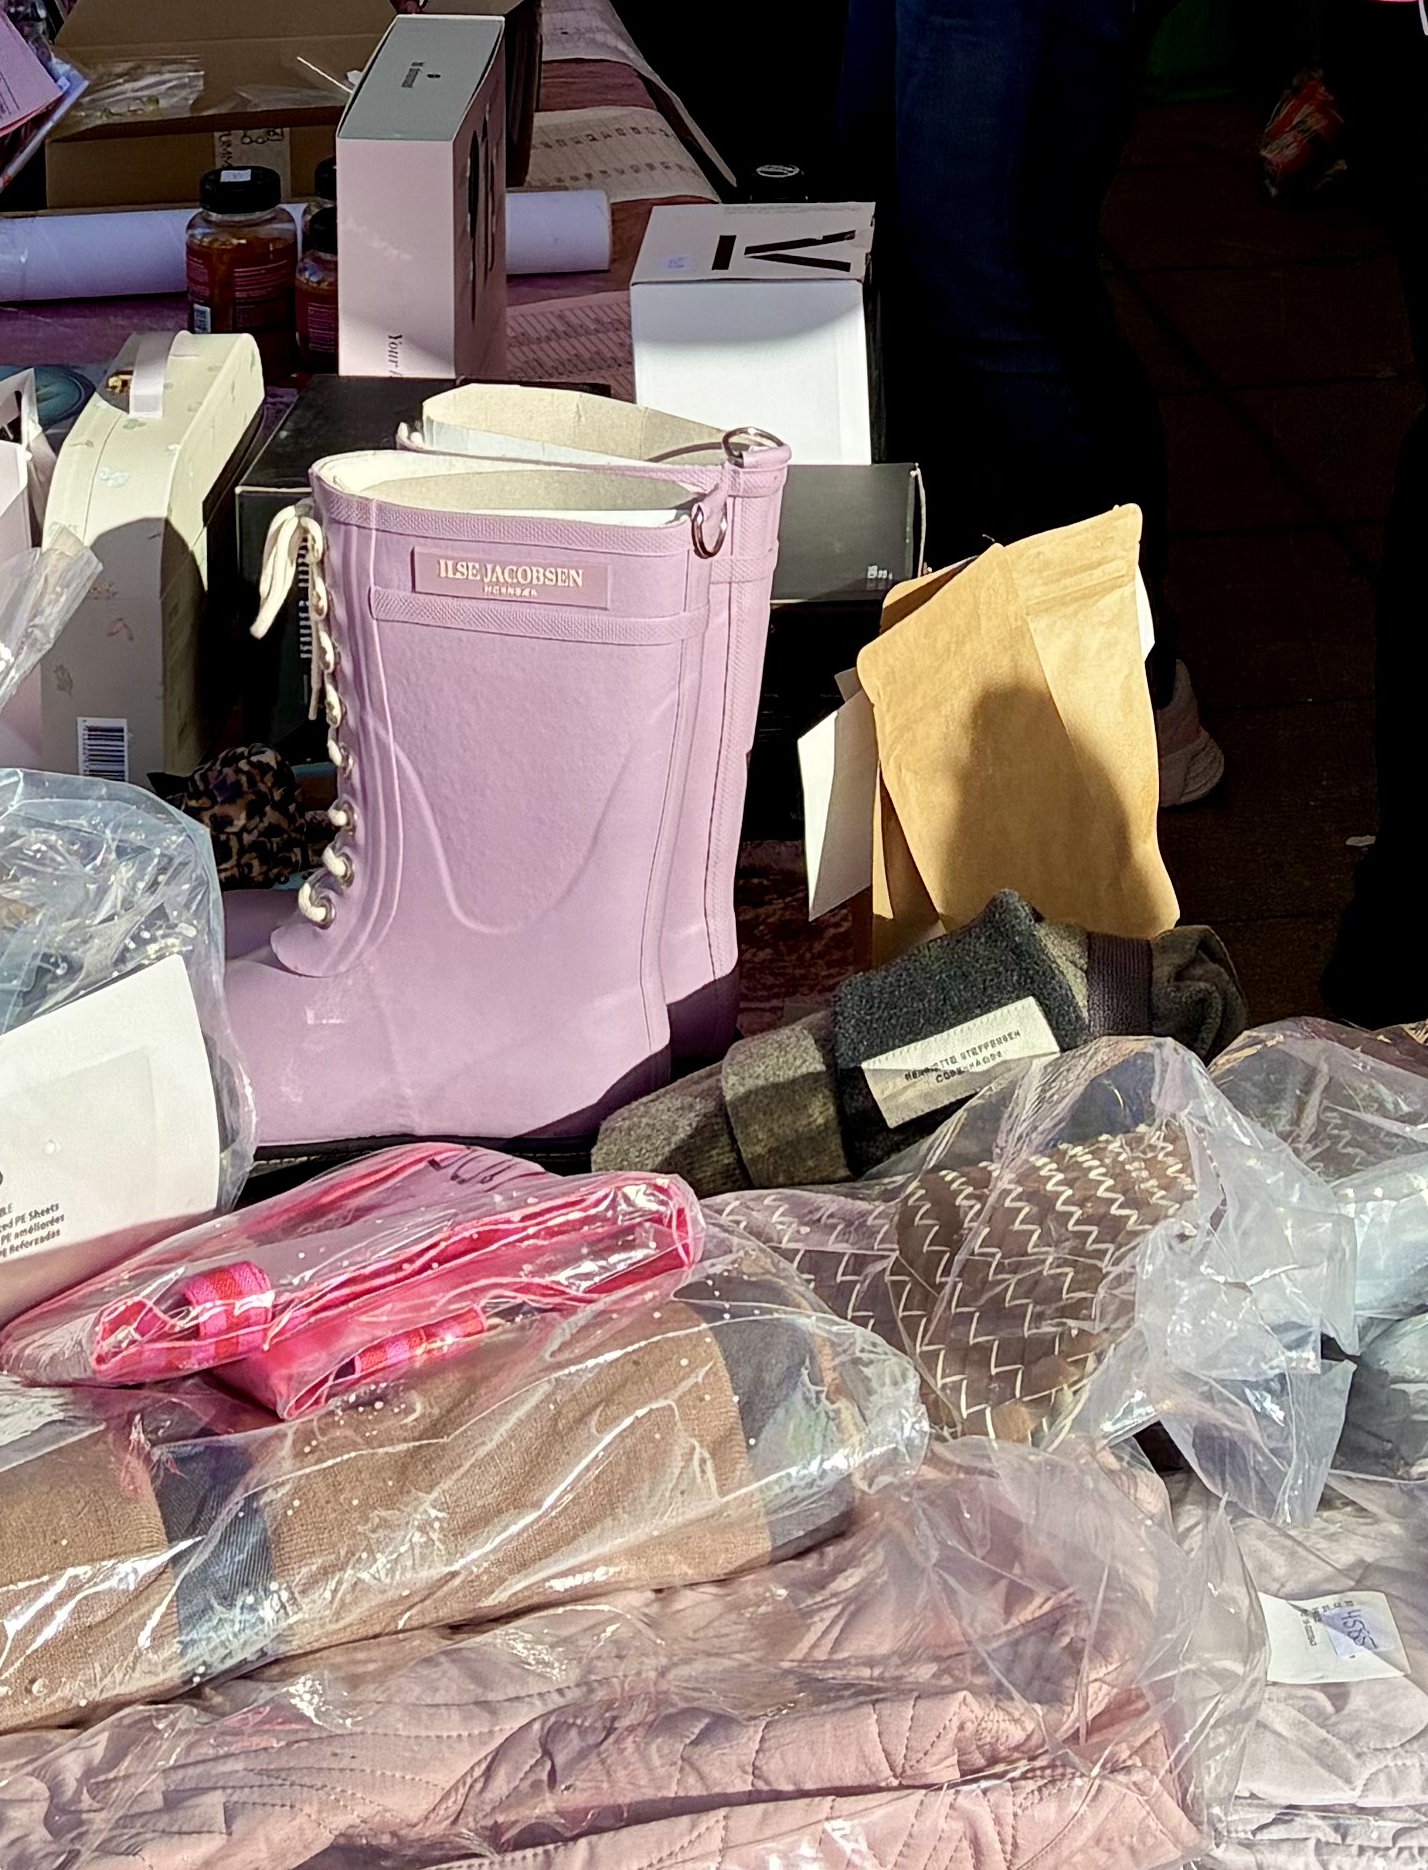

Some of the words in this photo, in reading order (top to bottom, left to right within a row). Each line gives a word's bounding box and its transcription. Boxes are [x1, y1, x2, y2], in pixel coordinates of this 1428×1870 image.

[387, 334, 403, 368] Your
[438, 559, 480, 580] ILSE
[482, 563, 583, 587] JACOBSEN
[15, 1213, 27, 1226] PE
[29, 1203, 60, 1221] Sheets
[0, 1233, 12, 1246] PE
